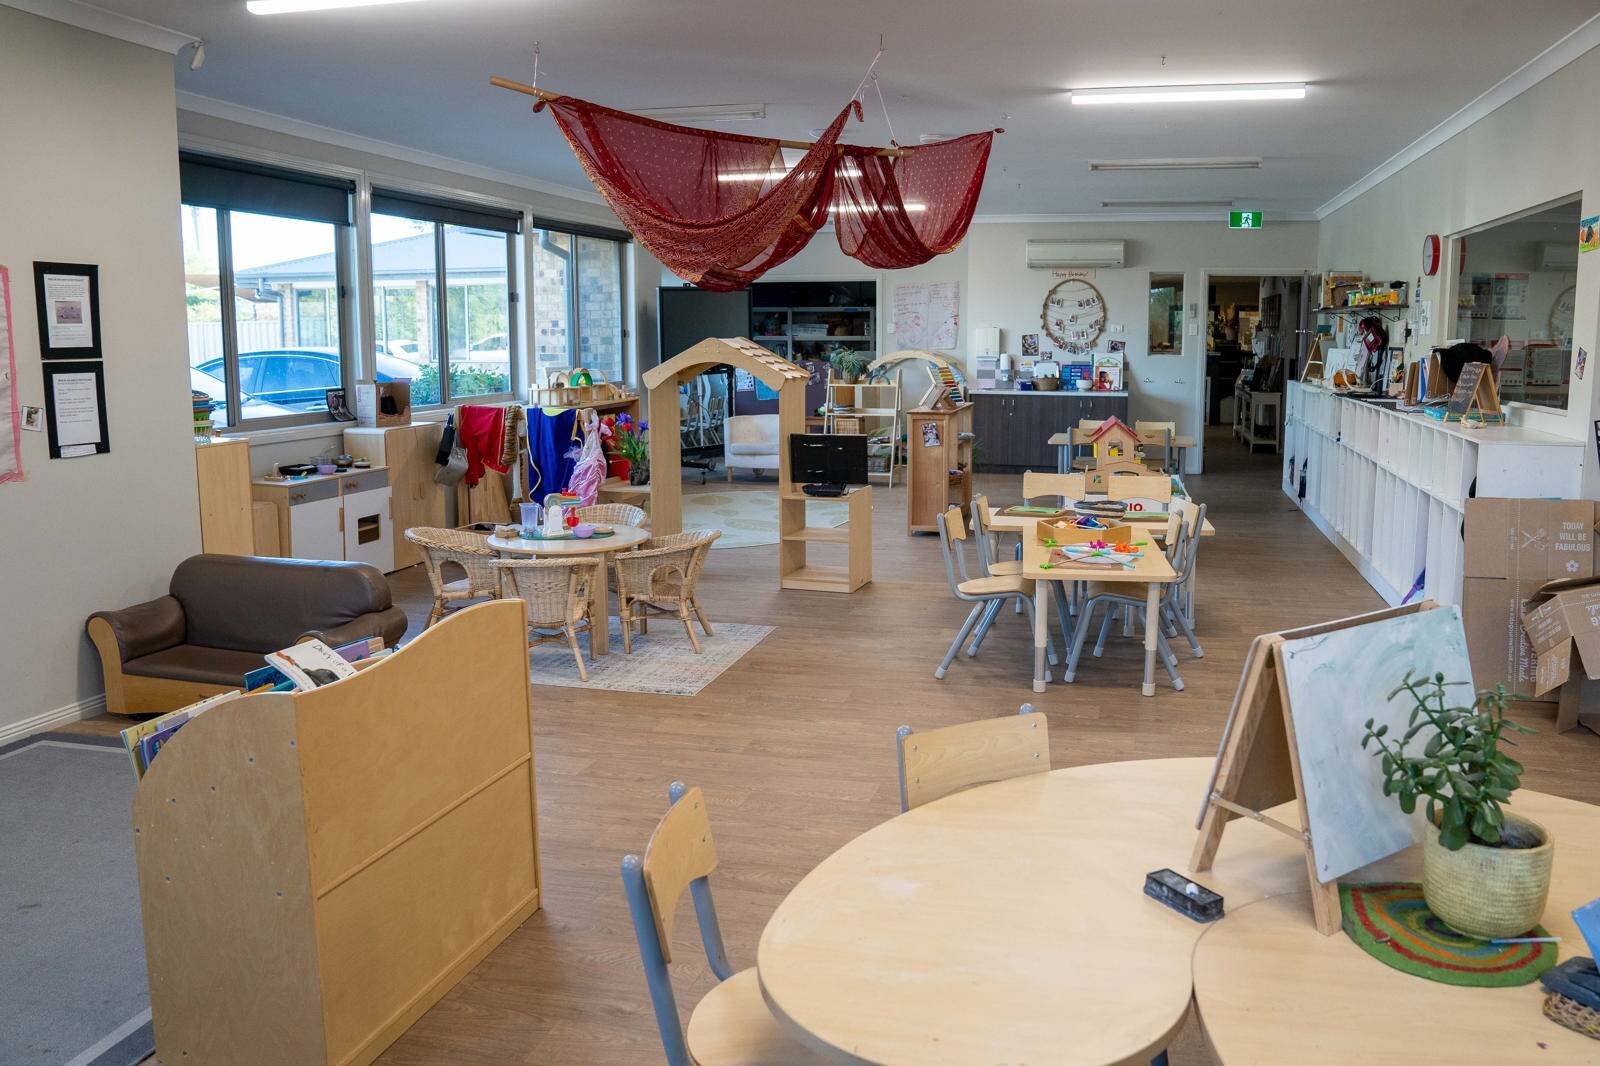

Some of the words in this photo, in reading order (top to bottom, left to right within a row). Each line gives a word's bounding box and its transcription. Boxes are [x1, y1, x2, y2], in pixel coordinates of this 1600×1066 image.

[1562, 522, 1584, 530] TODAY
[1559, 532, 1577, 541] WILL
[1577, 533, 1588, 541] BE
[1555, 543, 1591, 552] FABULOUS
[1519, 657, 1529, 682] Meals
